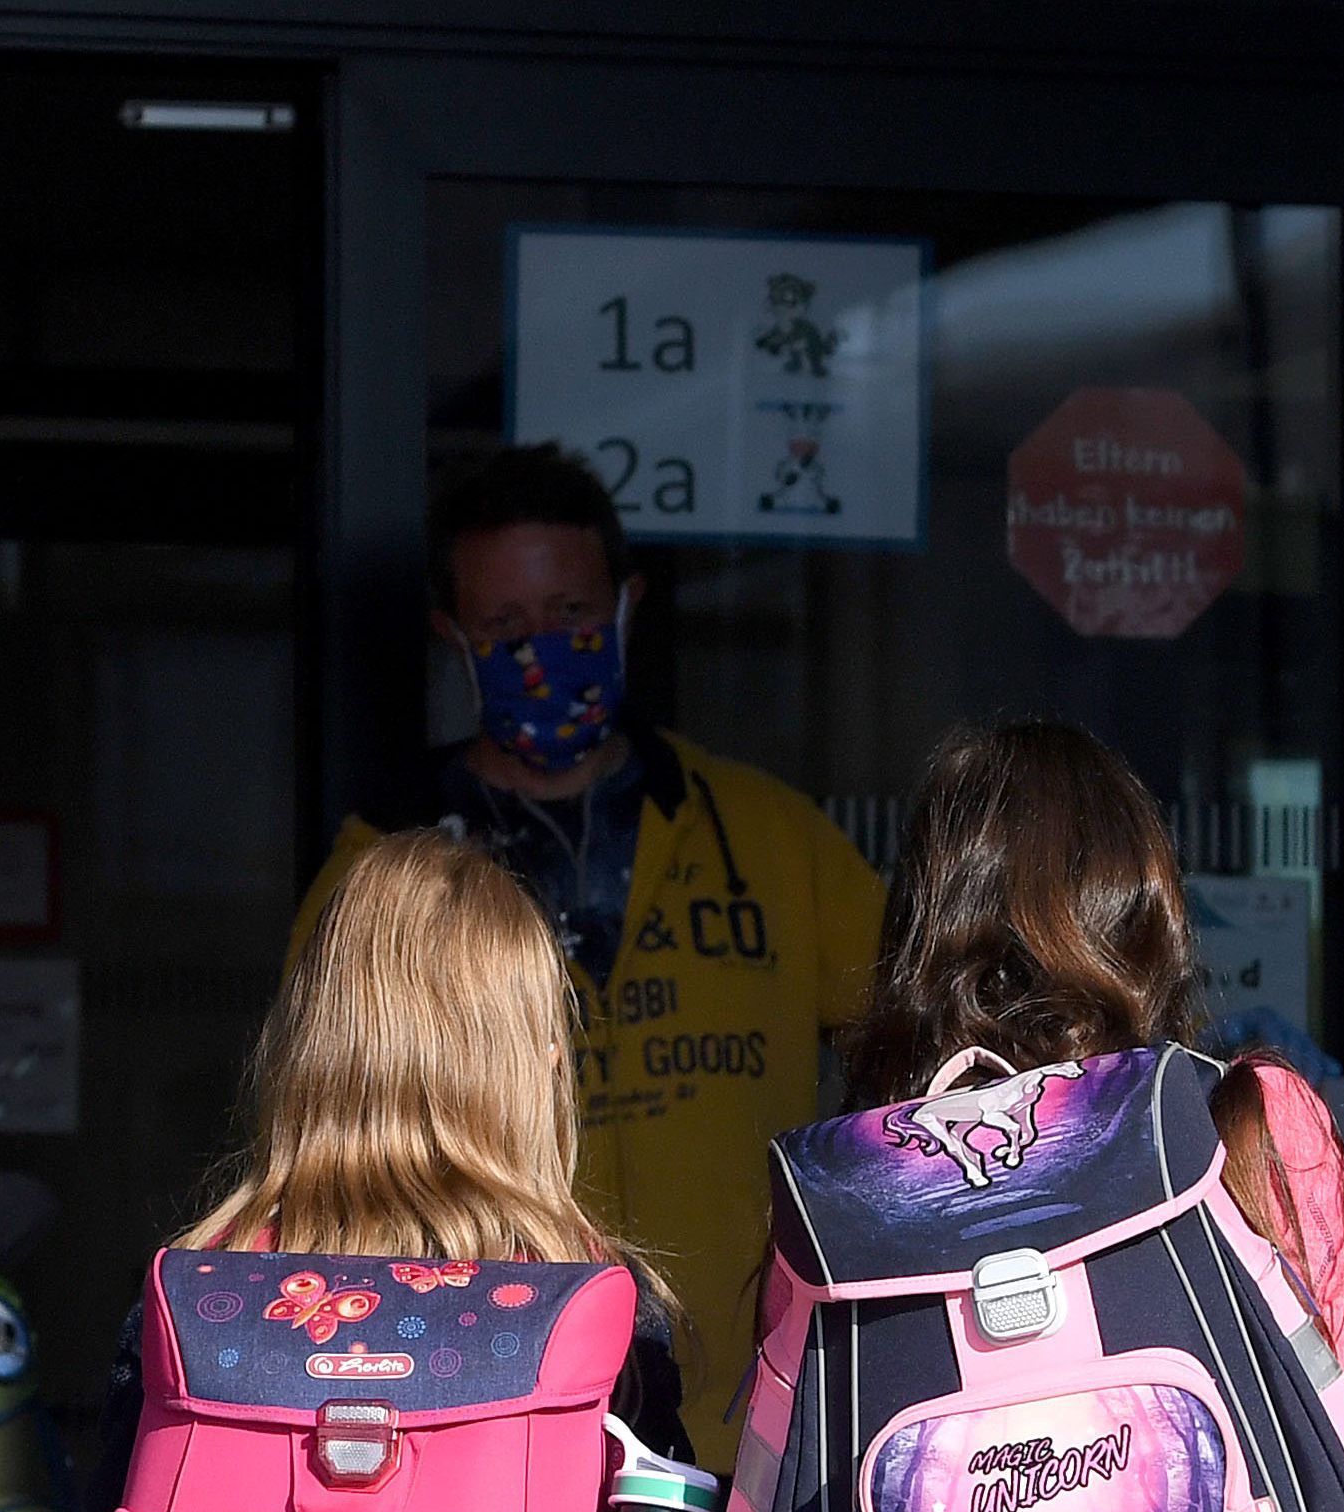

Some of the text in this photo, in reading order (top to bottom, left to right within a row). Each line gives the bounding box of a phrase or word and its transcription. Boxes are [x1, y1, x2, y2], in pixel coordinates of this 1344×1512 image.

[599, 296, 695, 371] 1a
[597, 437, 695, 514] 2a
[1074, 436, 1183, 474] Eltern
[643, 1031, 766, 1080] GOODS
[967, 1437, 1055, 1475] MAGIC
